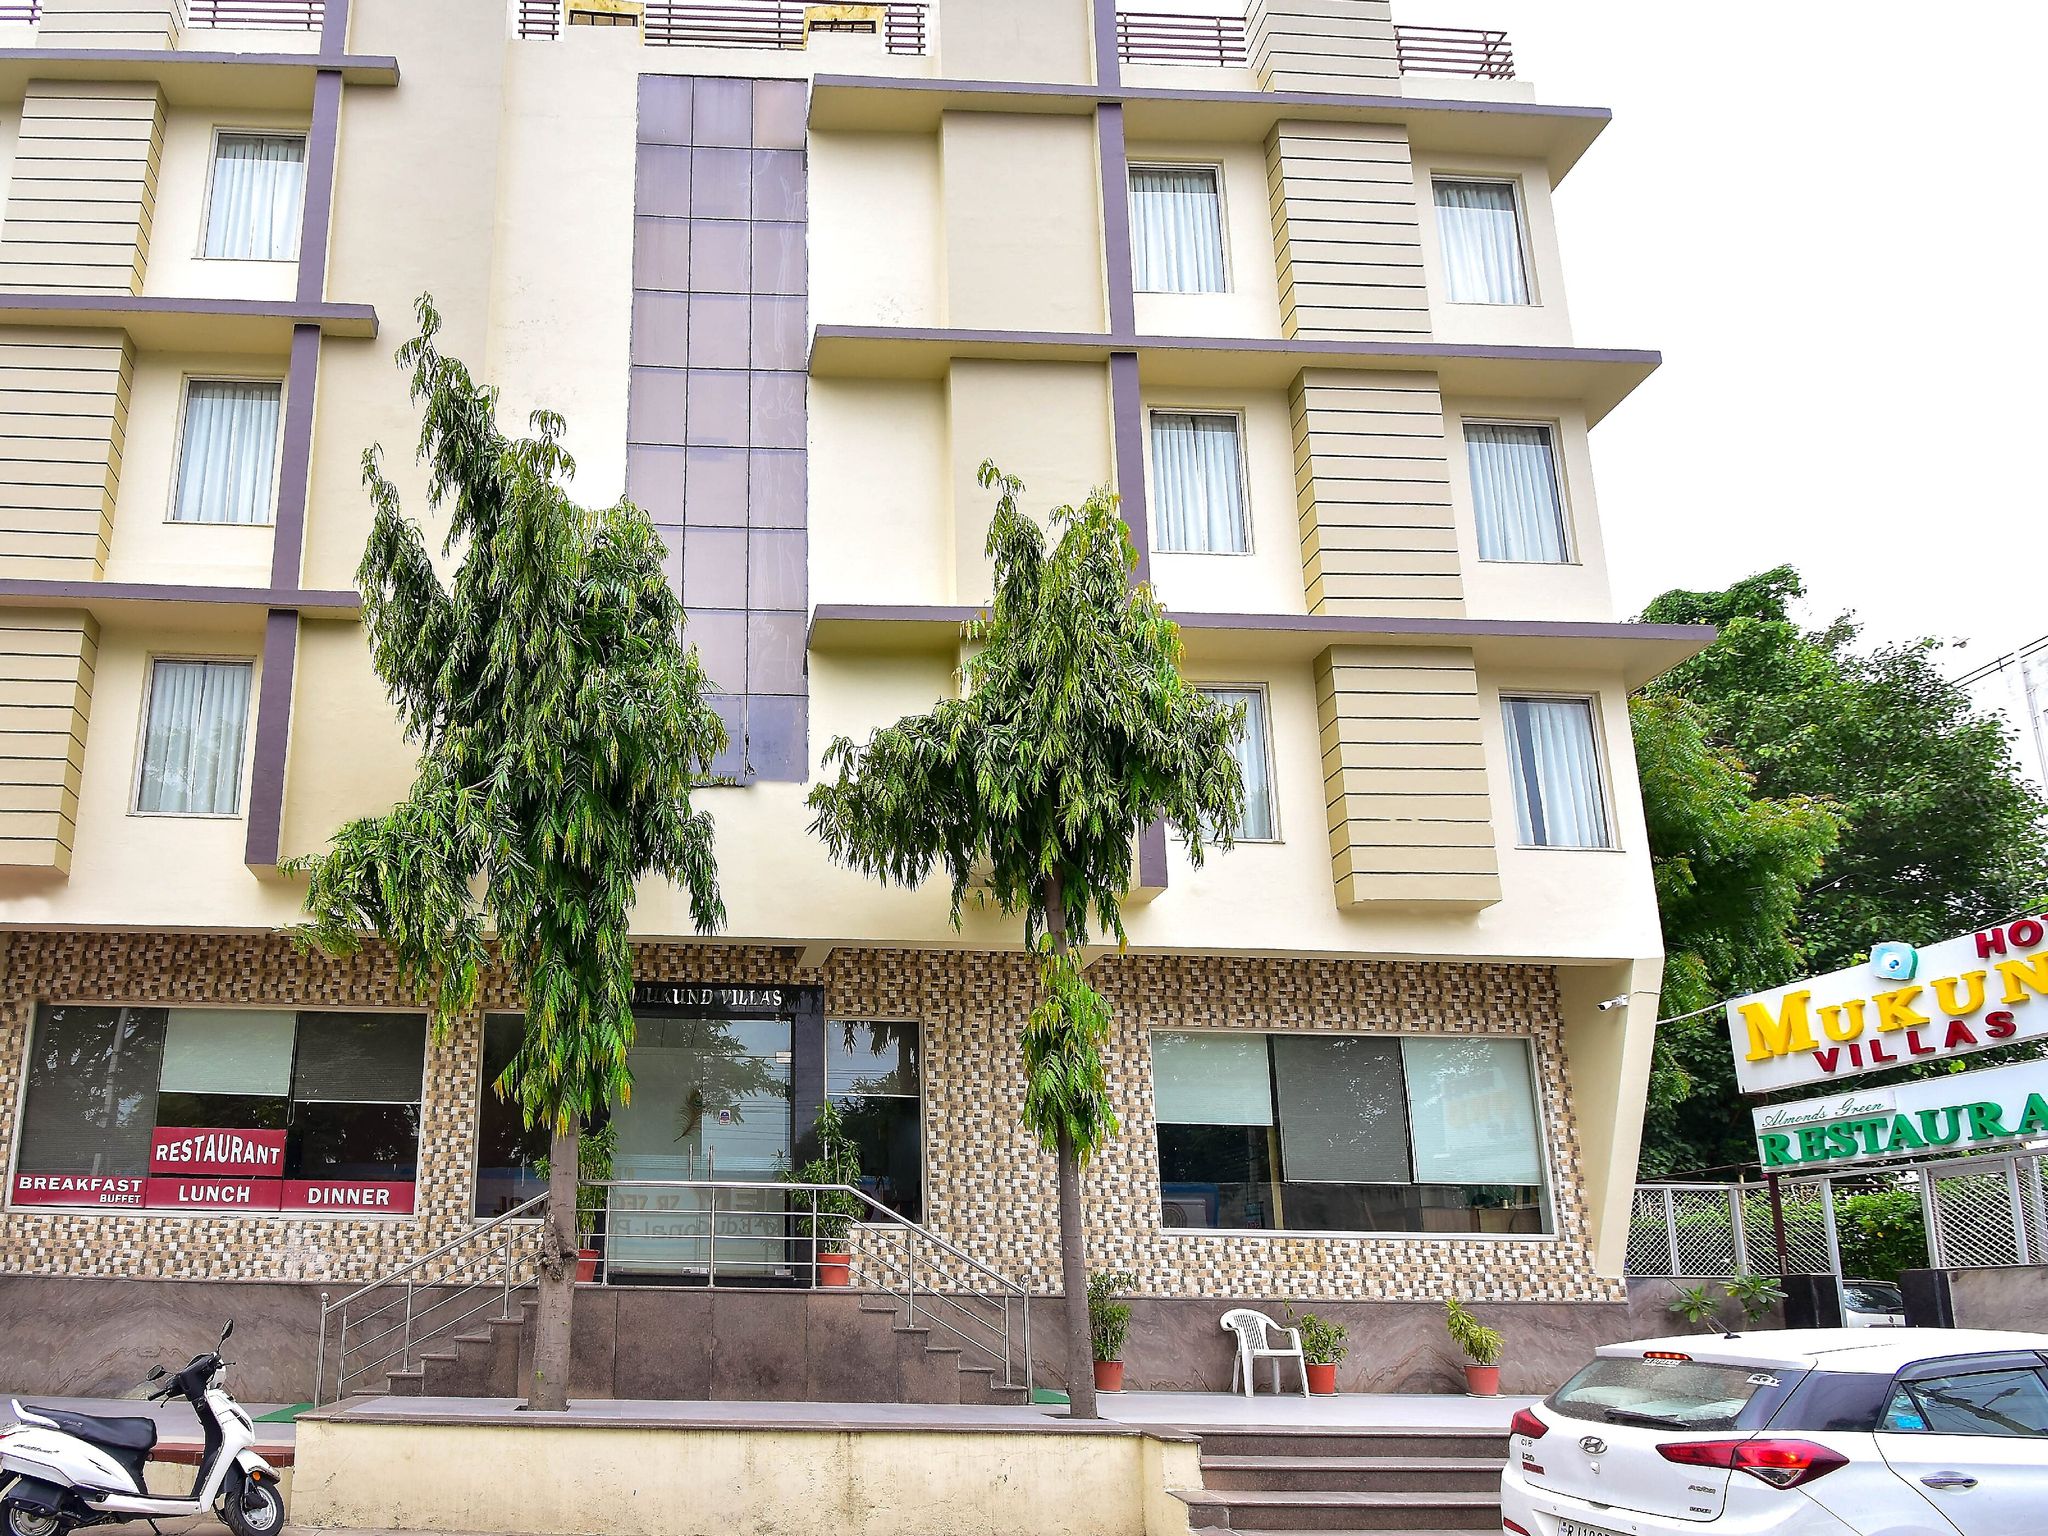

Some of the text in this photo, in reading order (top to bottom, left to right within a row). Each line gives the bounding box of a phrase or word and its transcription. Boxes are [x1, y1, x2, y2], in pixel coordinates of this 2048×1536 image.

[1975, 913, 2048, 958] HO
[720, 988, 782, 1006] VILLAS
[1813, 1010, 2017, 1072] VILLAS
[1762, 1097, 1885, 1128] Almonds Green
[155, 1133, 282, 1166] RESTAURANT
[19, 1177, 143, 1194] BREAKFAST
[178, 1184, 250, 1204] LUNCH
[99, 1193, 142, 1205] BUFFET
[307, 1186, 390, 1207] DINNER
